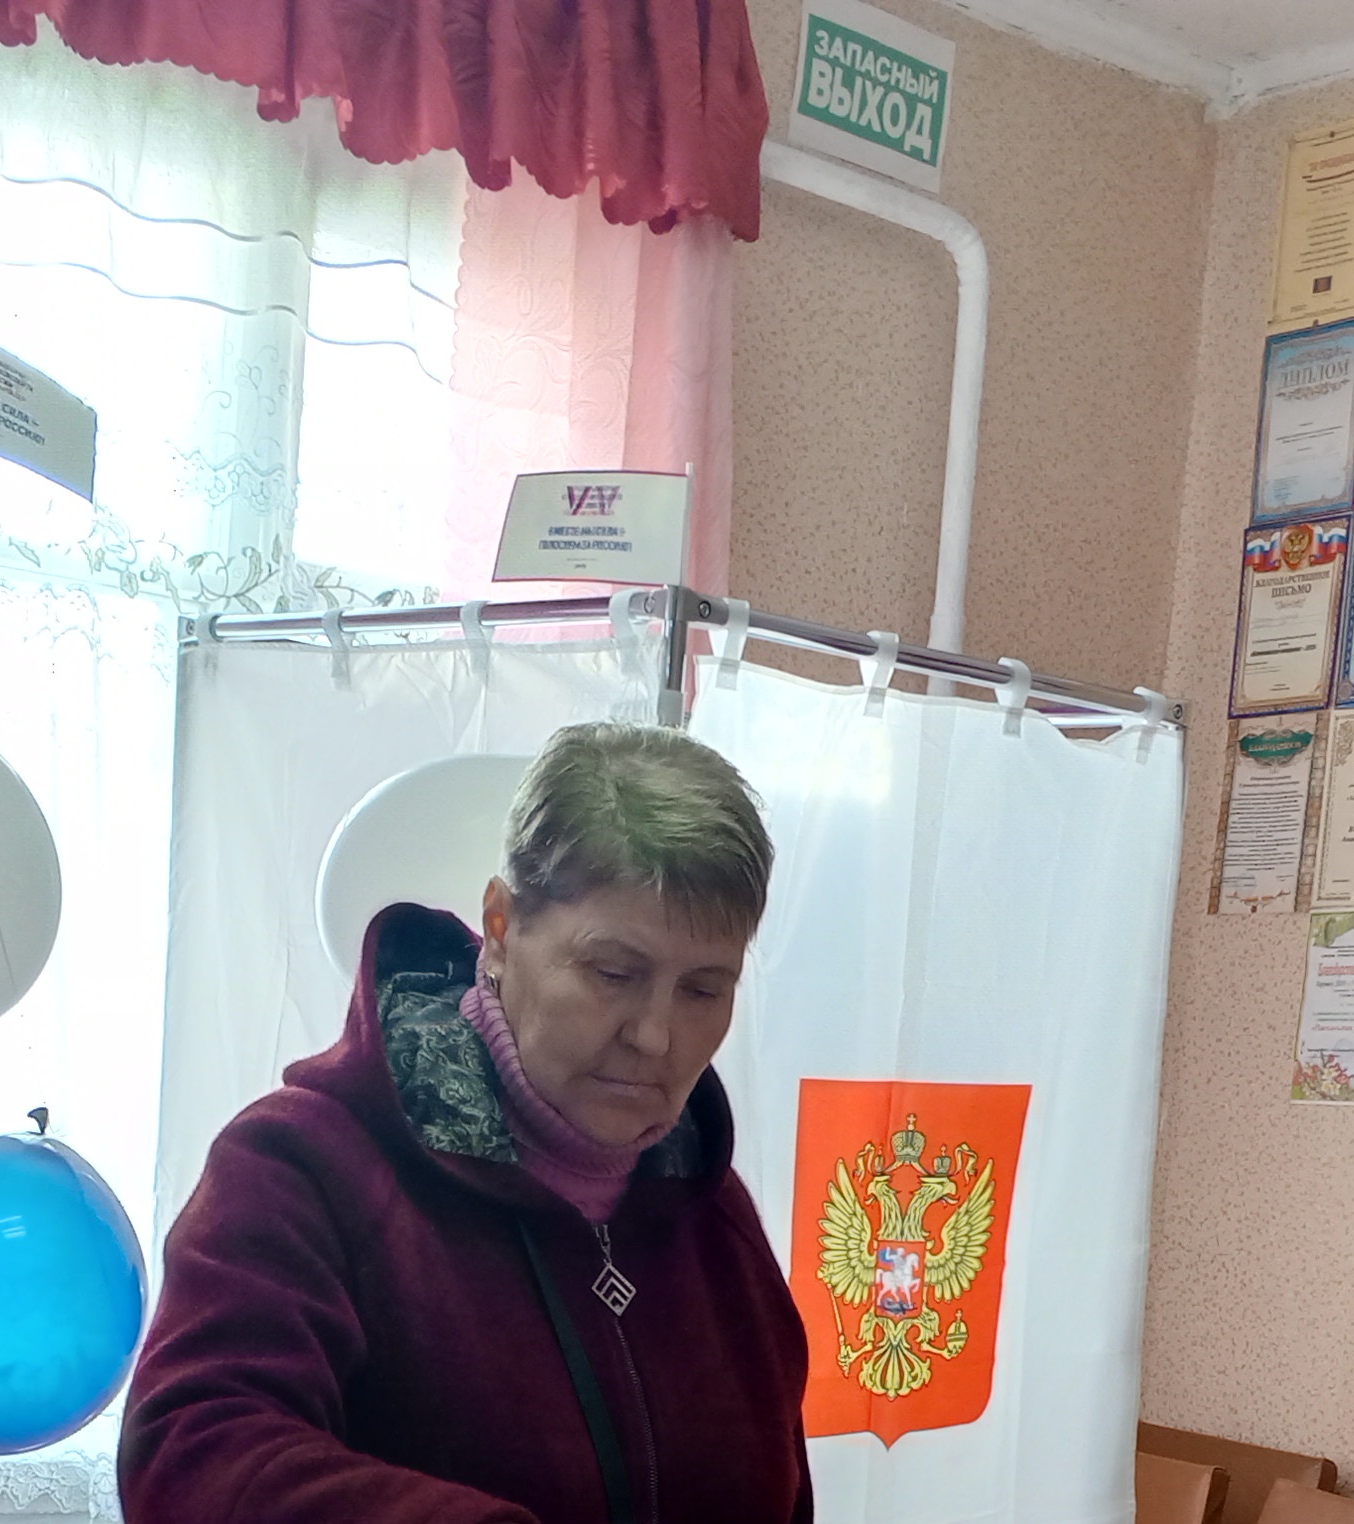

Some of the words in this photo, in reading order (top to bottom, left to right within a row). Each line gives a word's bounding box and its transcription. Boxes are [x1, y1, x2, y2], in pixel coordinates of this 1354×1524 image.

[814, 29, 940, 104] ЗАПАСНЫЙ
[807, 58, 934, 162] ВЫХОД
[1278, 359, 1350, 390] ДИПЛОМ
